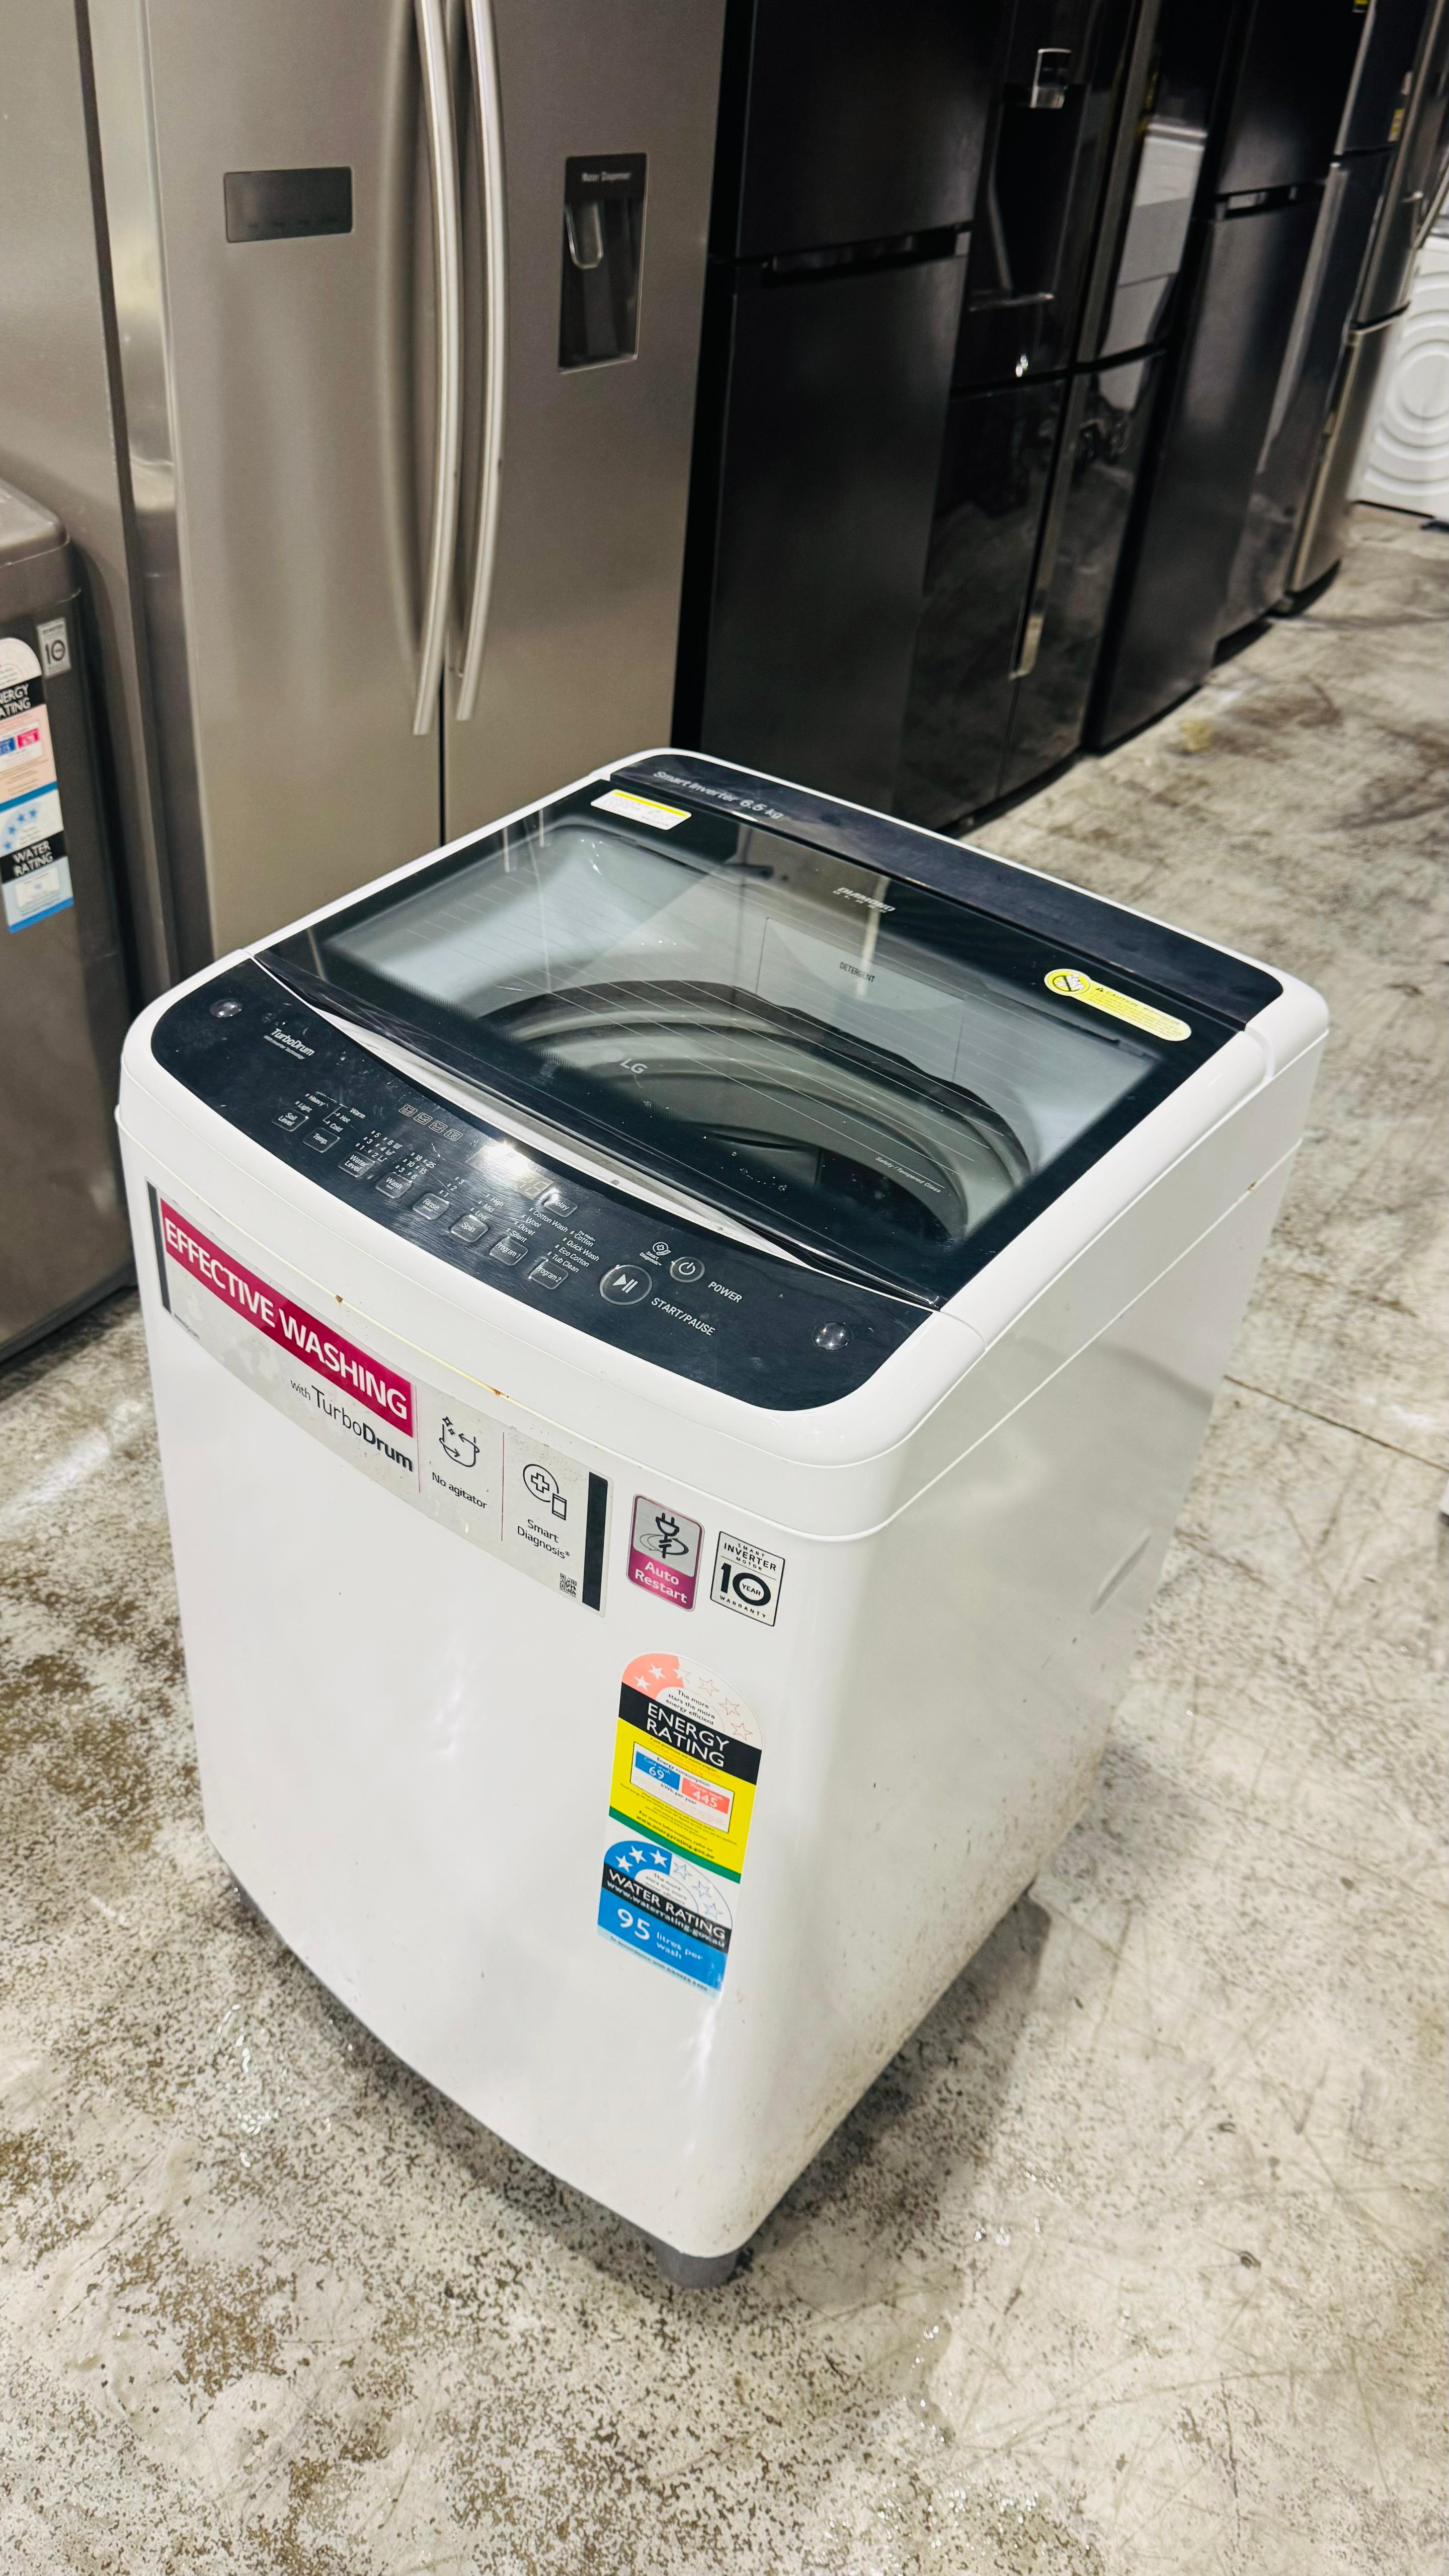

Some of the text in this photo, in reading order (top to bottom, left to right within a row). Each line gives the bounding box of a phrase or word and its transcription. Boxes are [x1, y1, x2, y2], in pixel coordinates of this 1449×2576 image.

[653, 771, 784, 820] Smart Inverter 6.5 kg
[12, 840, 51, 863] WATER
[13, 852, 54, 877] RATING
[837, 887, 896, 912] DIAMOND
[271, 1028, 315, 1056] TurboDrum
[620, 1058, 648, 1074] LG
[278, 1115, 295, 1126] Level
[330, 1123, 344, 1133] Cold
[339, 1114, 351, 1123] Hot
[344, 1160, 362, 1172] Level
[349, 1154, 369, 1167] Water
[385, 1177, 403, 1190] Wash
[875, 1157, 894, 1168] Safety
[924, 1182, 941, 1193] Glass
[423, 1198, 440, 1211] Rinse
[482, 1203, 495, 1213] Mid
[491, 1197, 504, 1207] High
[474, 1210, 489, 1220] Low
[526, 1216, 542, 1228] Wool
[533, 1209, 569, 1233] Cotton Wash
[461, 1221, 476, 1233] Spin
[510, 1230, 528, 1243] Silent
[495, 1241, 517, 1257] Program
[567, 1240, 600, 1261] Quick Wash
[575, 1233, 594, 1247] Cotton
[552, 1254, 580, 1273] Tub Clean
[558, 1247, 590, 1267] Eco Cotton
[708, 1281, 742, 1303] POWER
[165, 1217, 407, 1420] EFFECTIVE WASHING
[651, 1297, 715, 1336] START/PAUSE
[290, 1380, 414, 1472] with TurboDrum
[432, 1472, 487, 1509] No agitator
[527, 1518, 559, 1543] Smart
[724, 1543, 777, 1571] INVERTER
[738, 1543, 765, 1557] SMART
[645, 1561, 680, 1586] Auto
[736, 1556, 762, 1571] MOTOR
[634, 1569, 688, 1604] Restart
[720, 1562, 771, 1606] 10
[742, 1583, 761, 1596] YEAR
[719, 1594, 766, 1618] WARRANTY
[668, 1694, 715, 1719] stars the more
[677, 1689, 709, 1709] The more
[666, 1699, 714, 1726] energy efficient
[648, 1702, 730, 1752] ENERGY
[647, 1718, 726, 1767] RATING
[649, 1766, 665, 1780] 69
[692, 1791, 717, 1808] 445
[606, 1880, 725, 1948] www.waterrating.gov.au
[609, 1868, 661, 1908] WATER
[666, 1901, 726, 1940] RATING
[617, 1908, 650, 1941] 95
[656, 1931, 703, 1960] litres per
[656, 1942, 681, 1959] wash
